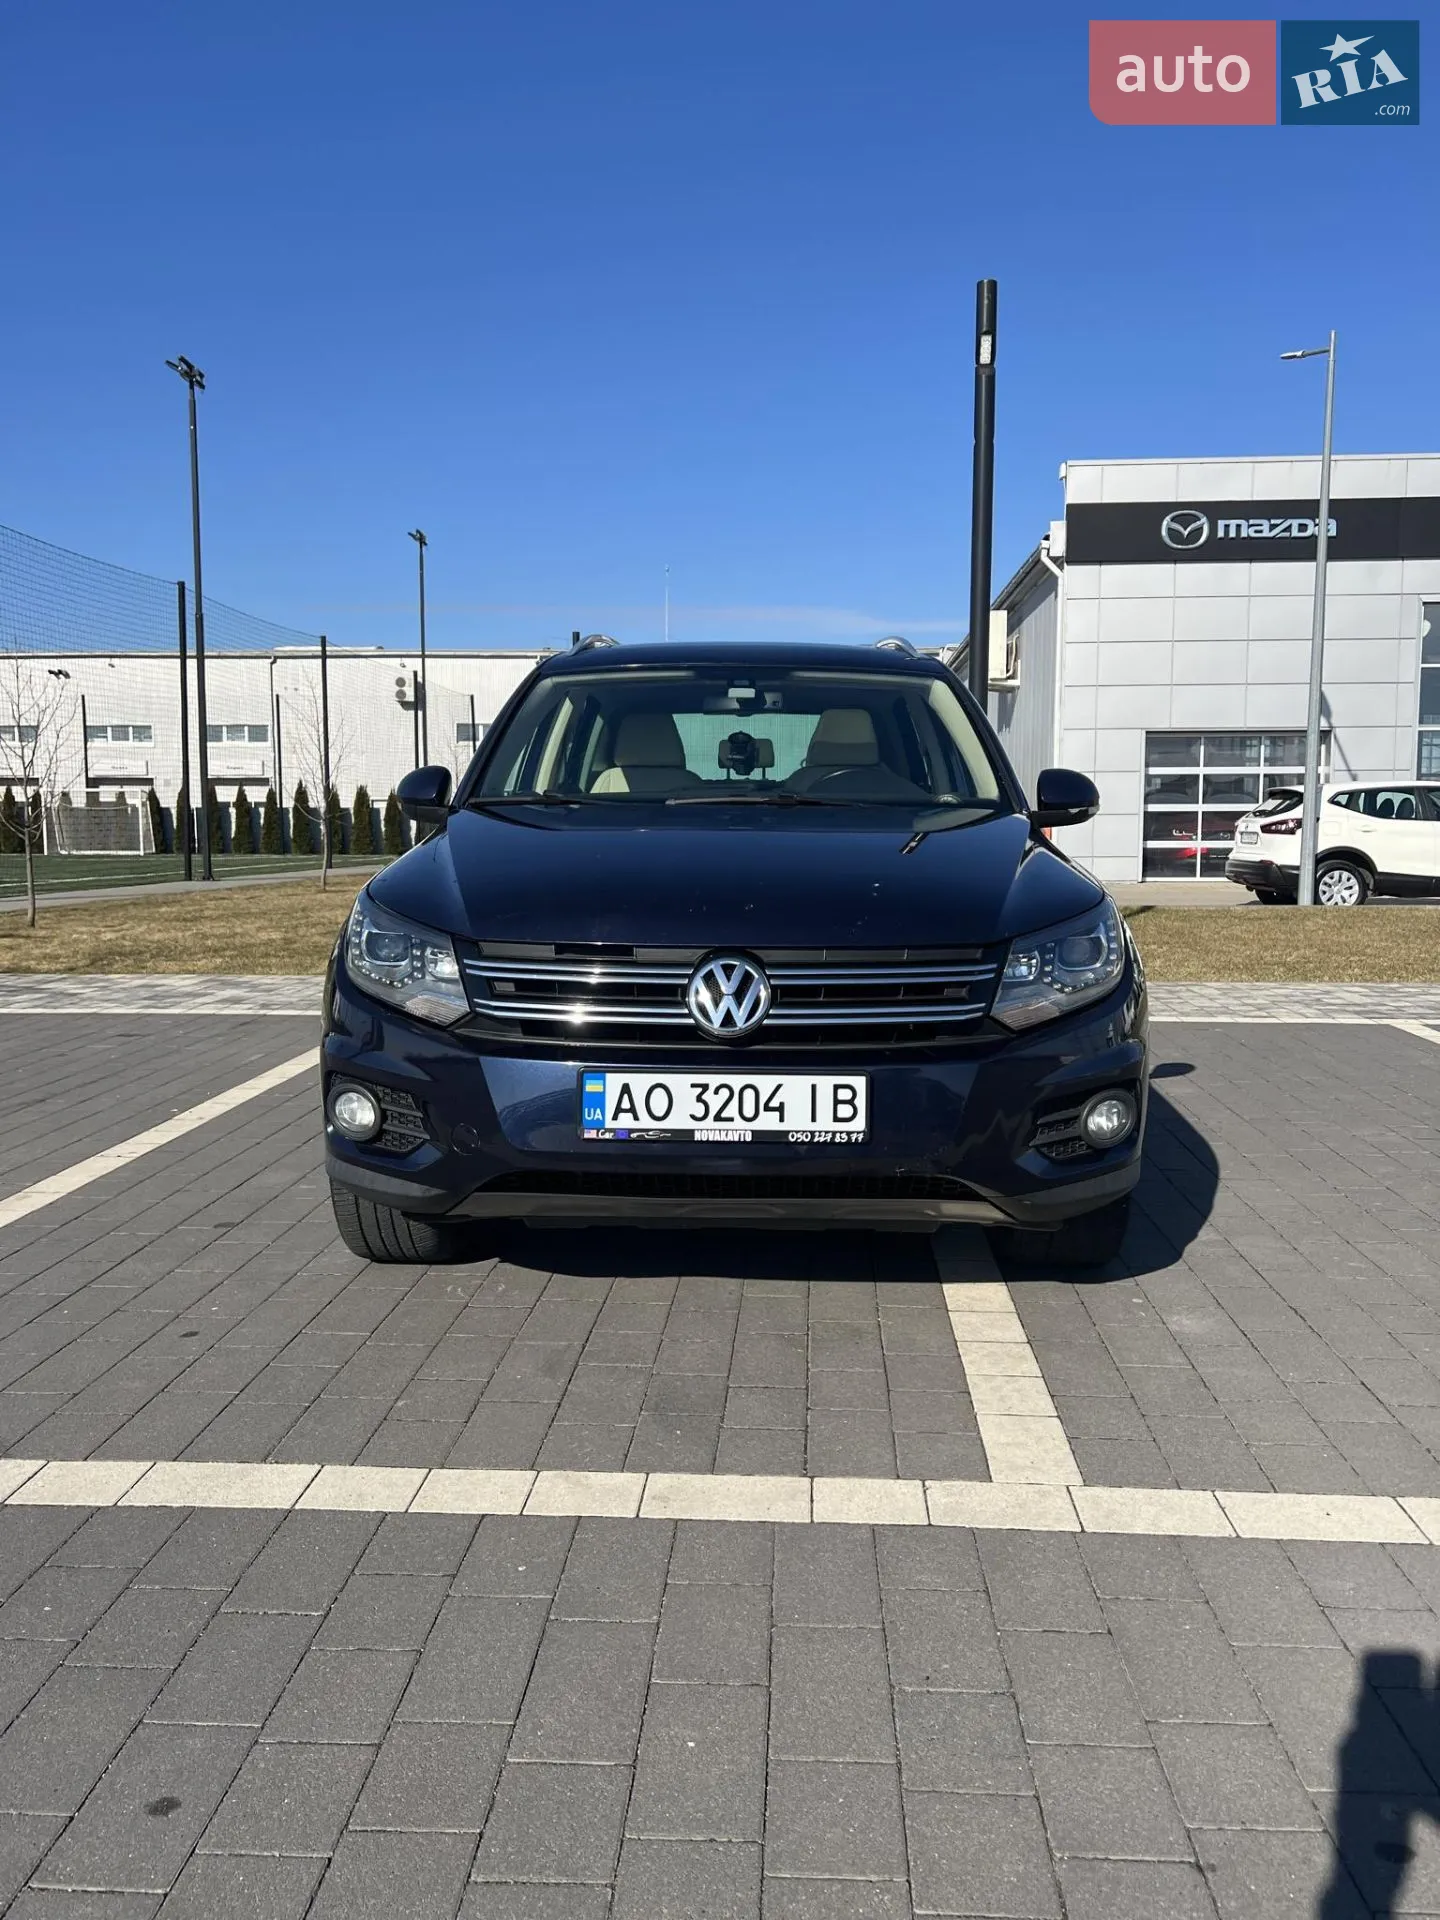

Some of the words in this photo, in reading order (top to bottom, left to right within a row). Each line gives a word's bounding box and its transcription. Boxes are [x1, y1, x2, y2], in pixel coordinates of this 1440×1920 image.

[611, 1083, 674, 1121] AO
[689, 1083, 785, 1123] 3204
[810, 1084, 859, 1123] IB
[584, 1108, 603, 1121] UA
[694, 1130, 752, 1142] NOVAKAVTO
[788, 1131, 811, 1143] 050
